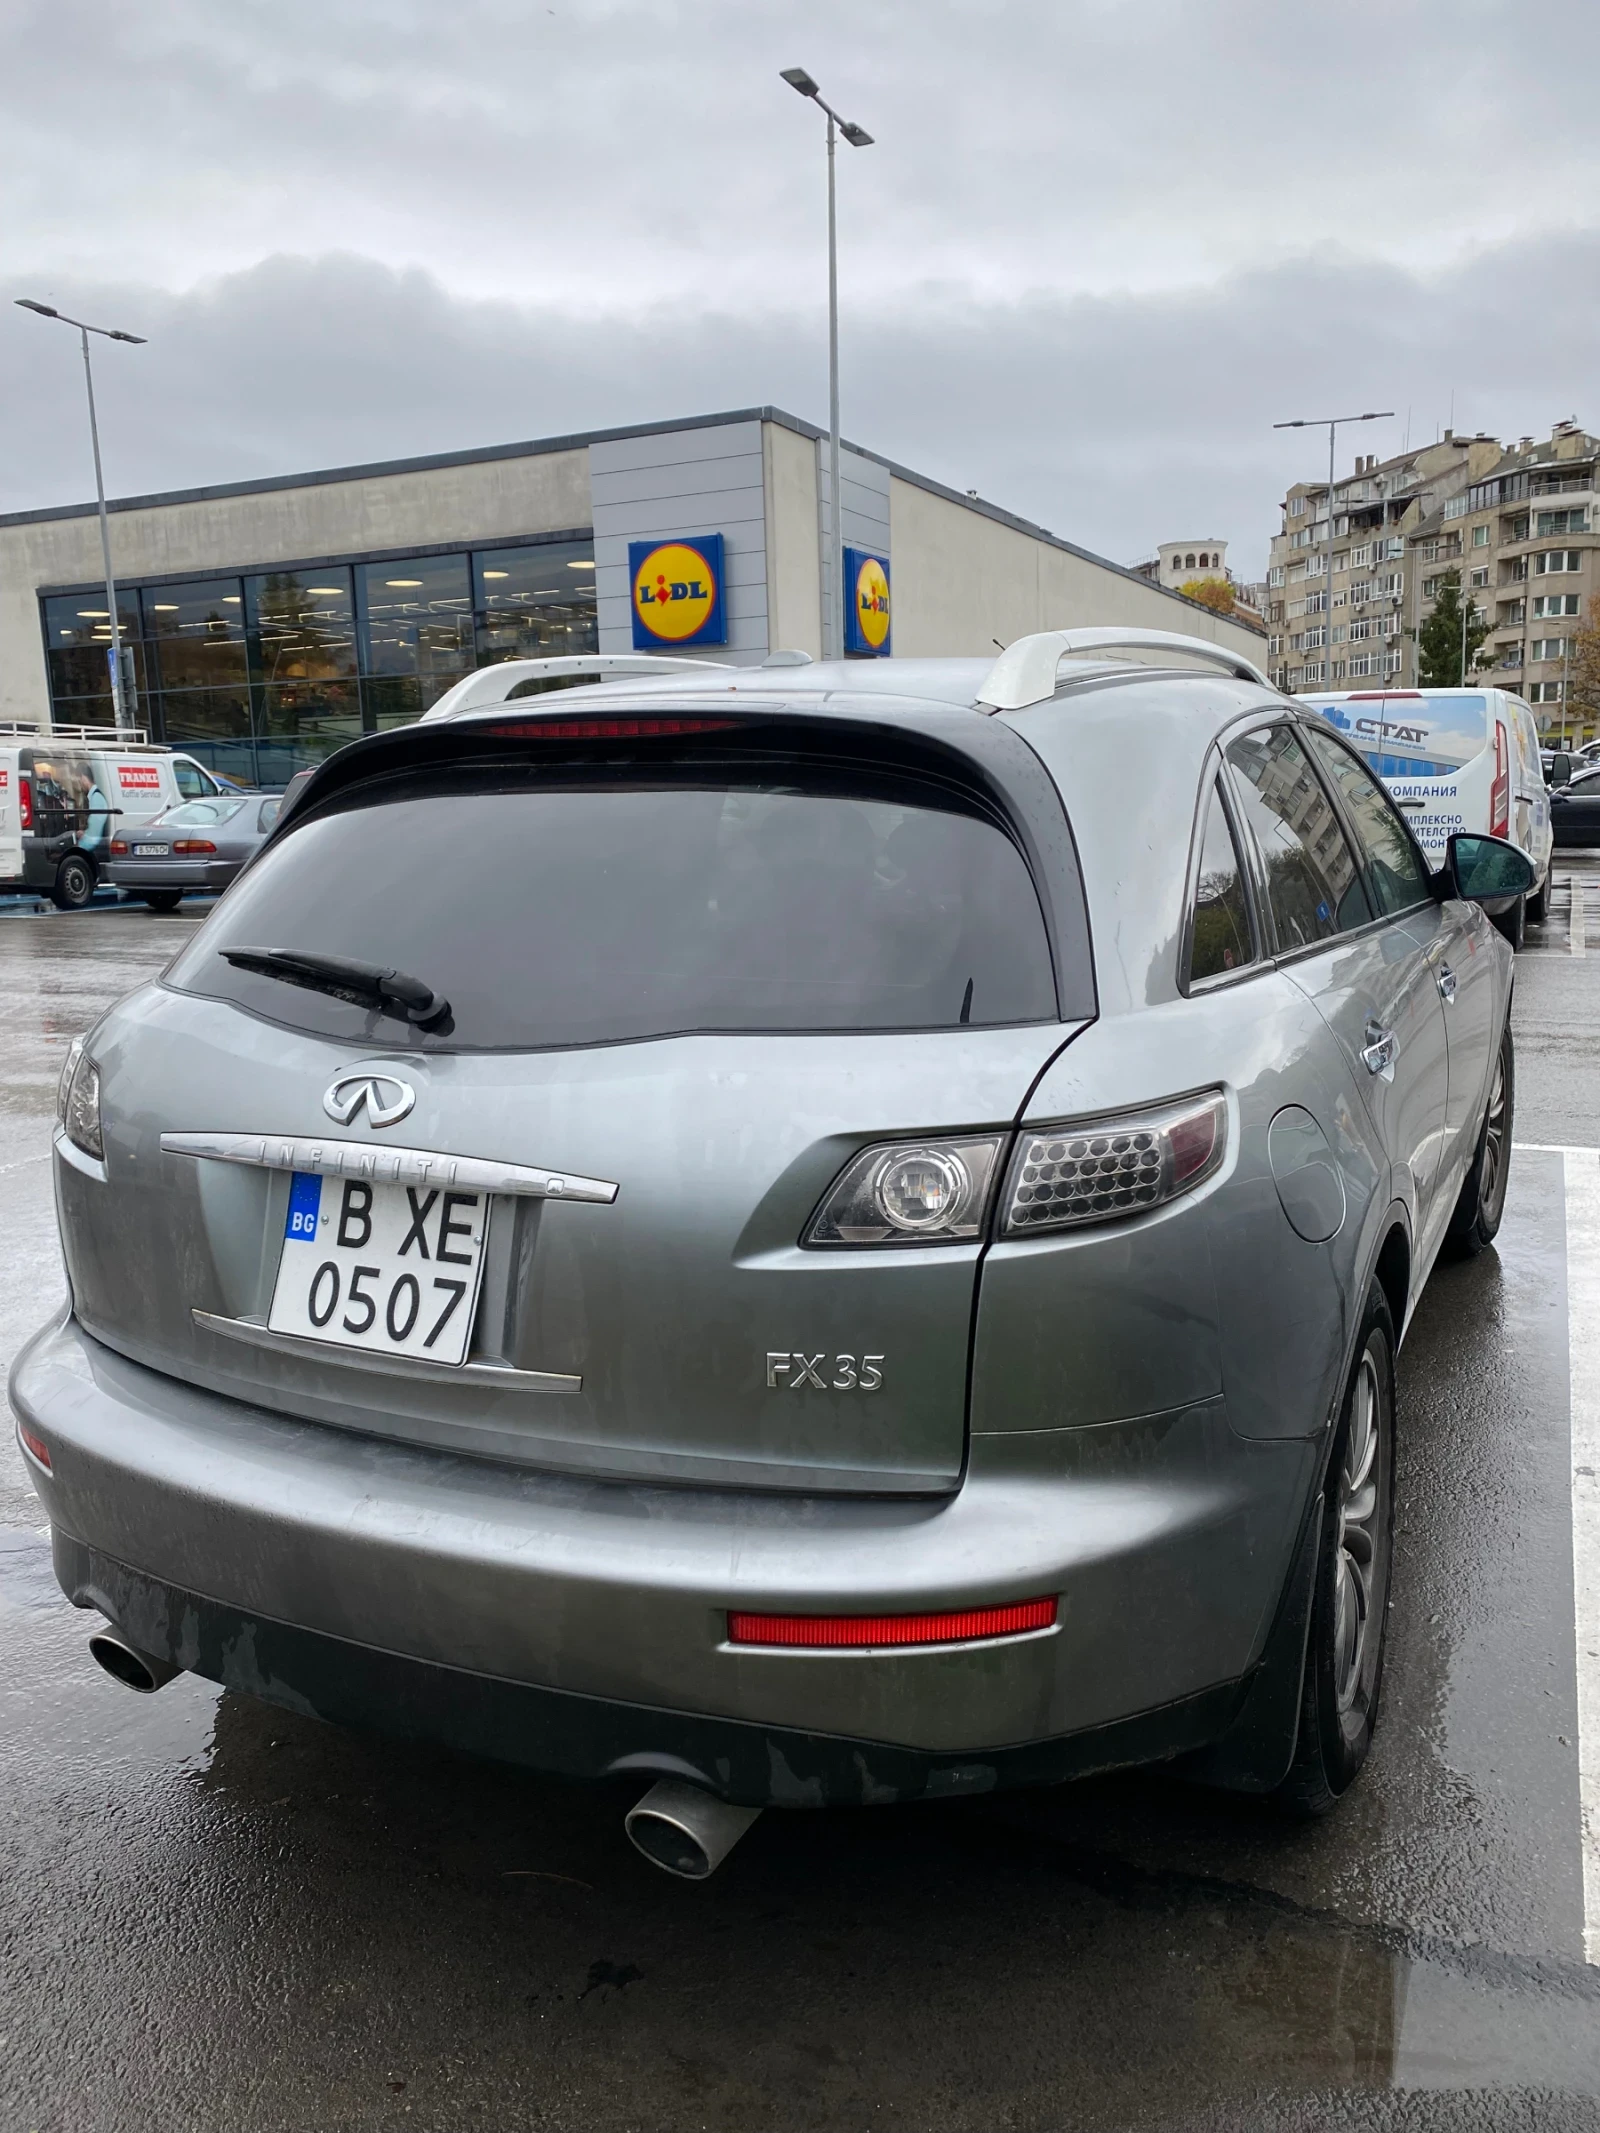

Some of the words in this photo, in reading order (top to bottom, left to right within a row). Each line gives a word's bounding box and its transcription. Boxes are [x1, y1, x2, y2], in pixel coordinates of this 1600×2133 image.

[1356, 718, 1429, 743] СТАТ
[119, 772, 159, 783] FRANKE
[140, 789, 162, 798] Service
[1405, 815, 1462, 825] МПЛЕКСНО
[1413, 827, 1467, 837] ИТЕЛСТВО
[258, 1140, 457, 1185] INFINITI
[291, 1211, 315, 1233] BG
[308, 1261, 467, 1348] 0507
